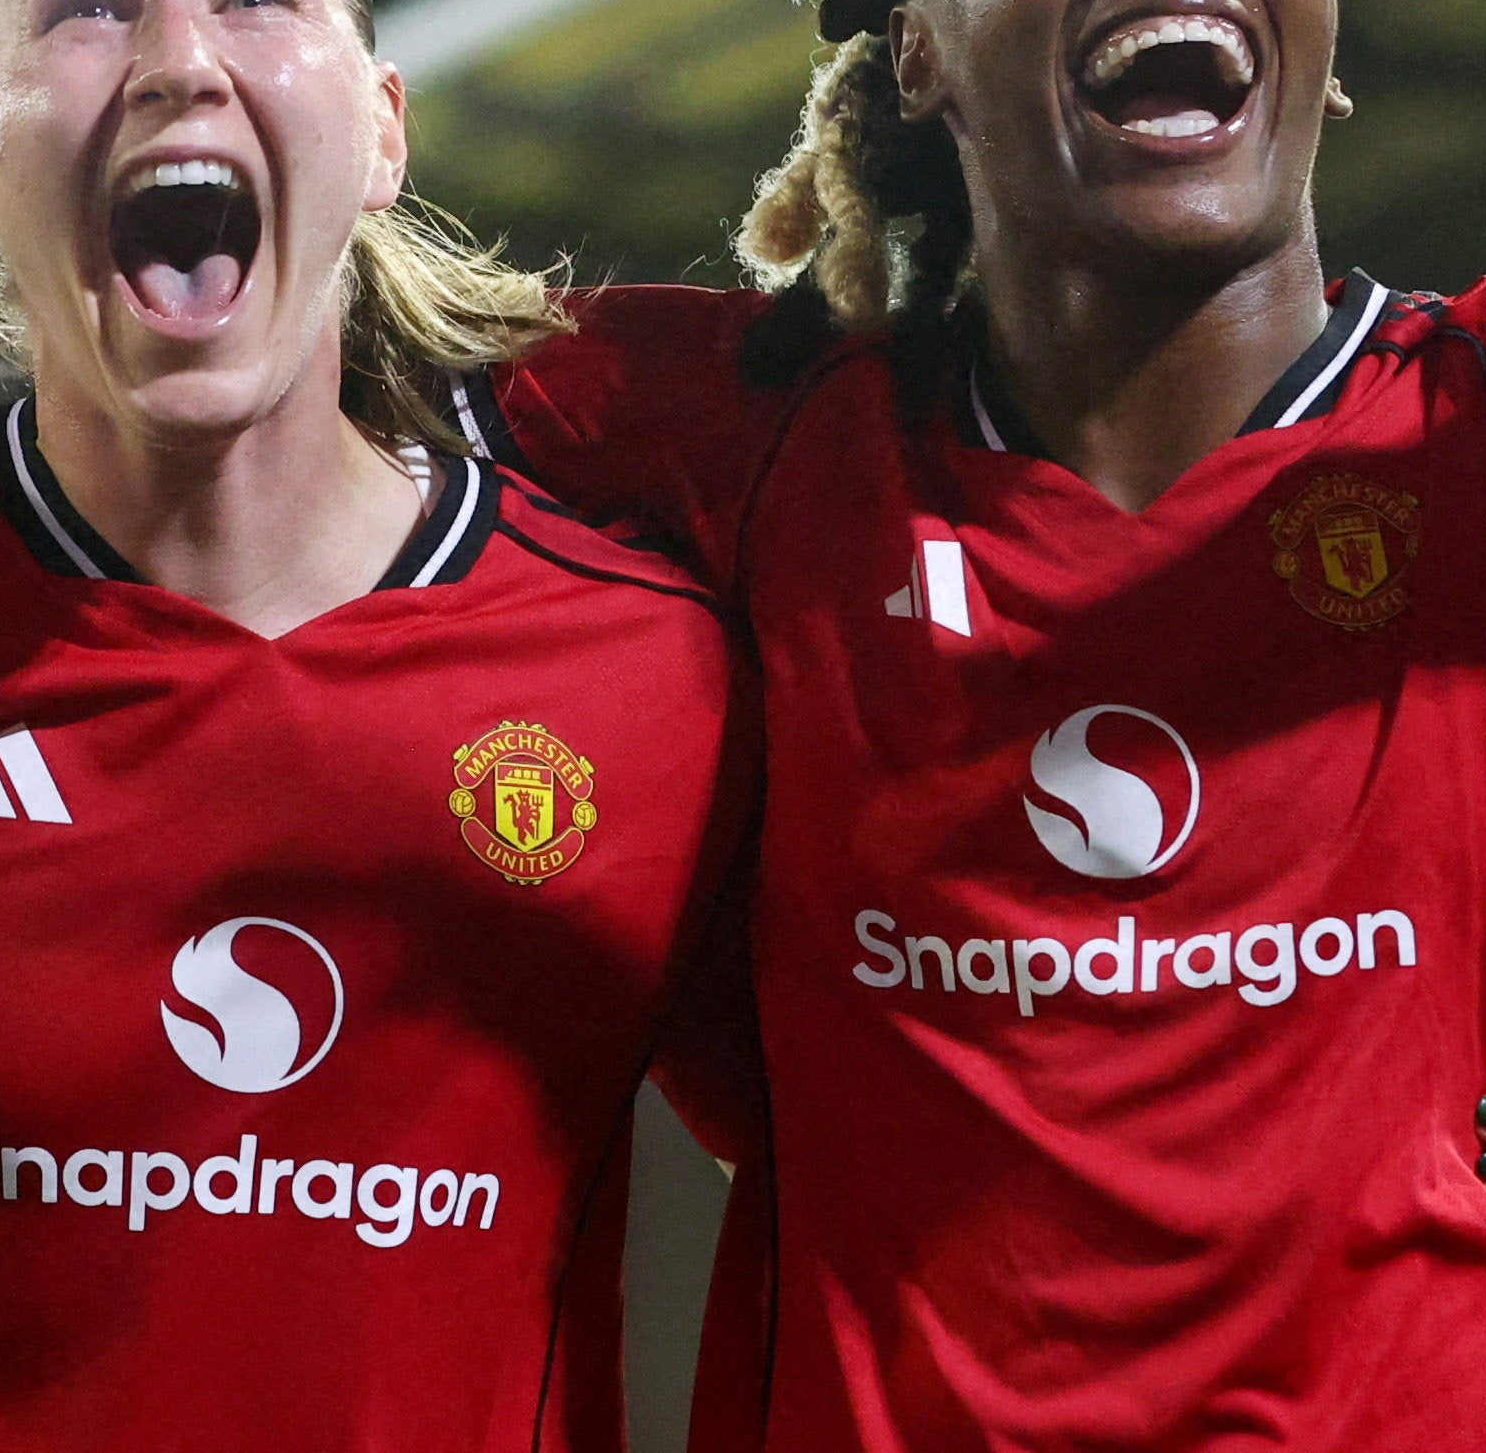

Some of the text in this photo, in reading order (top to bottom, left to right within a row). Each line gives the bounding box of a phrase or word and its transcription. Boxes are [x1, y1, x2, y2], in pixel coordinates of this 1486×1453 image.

[464, 733, 584, 789] MANCHESTER
[485, 841, 564, 874] UNITED
[852, 909, 1417, 1017] Snapdragon
